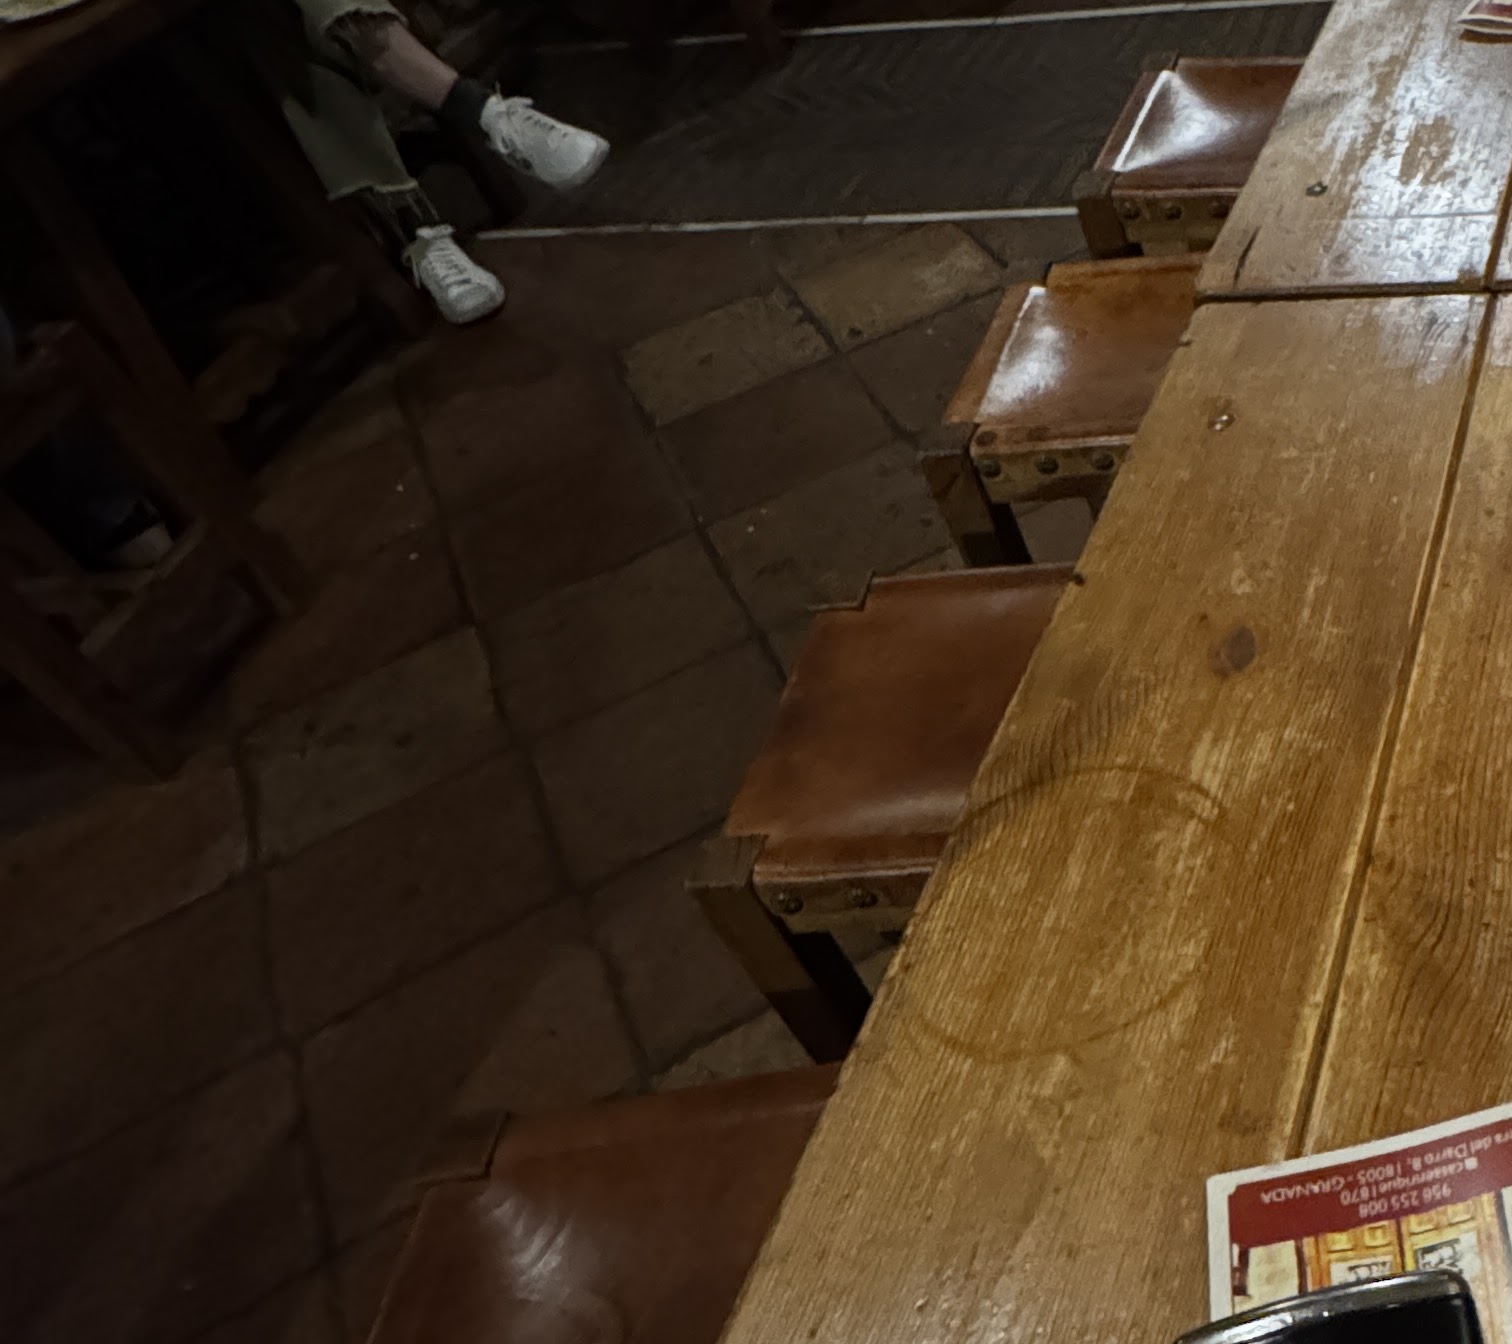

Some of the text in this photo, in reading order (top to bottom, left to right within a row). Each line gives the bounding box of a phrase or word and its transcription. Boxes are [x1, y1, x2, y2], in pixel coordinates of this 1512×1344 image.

[1423, 1141, 1468, 1166] Darro
[1469, 1136, 1493, 1155] del
[1356, 1161, 1402, 1185] 18005
[1260, 1175, 1345, 1205] GRANADA
[1389, 1189, 1420, 1213] 255
